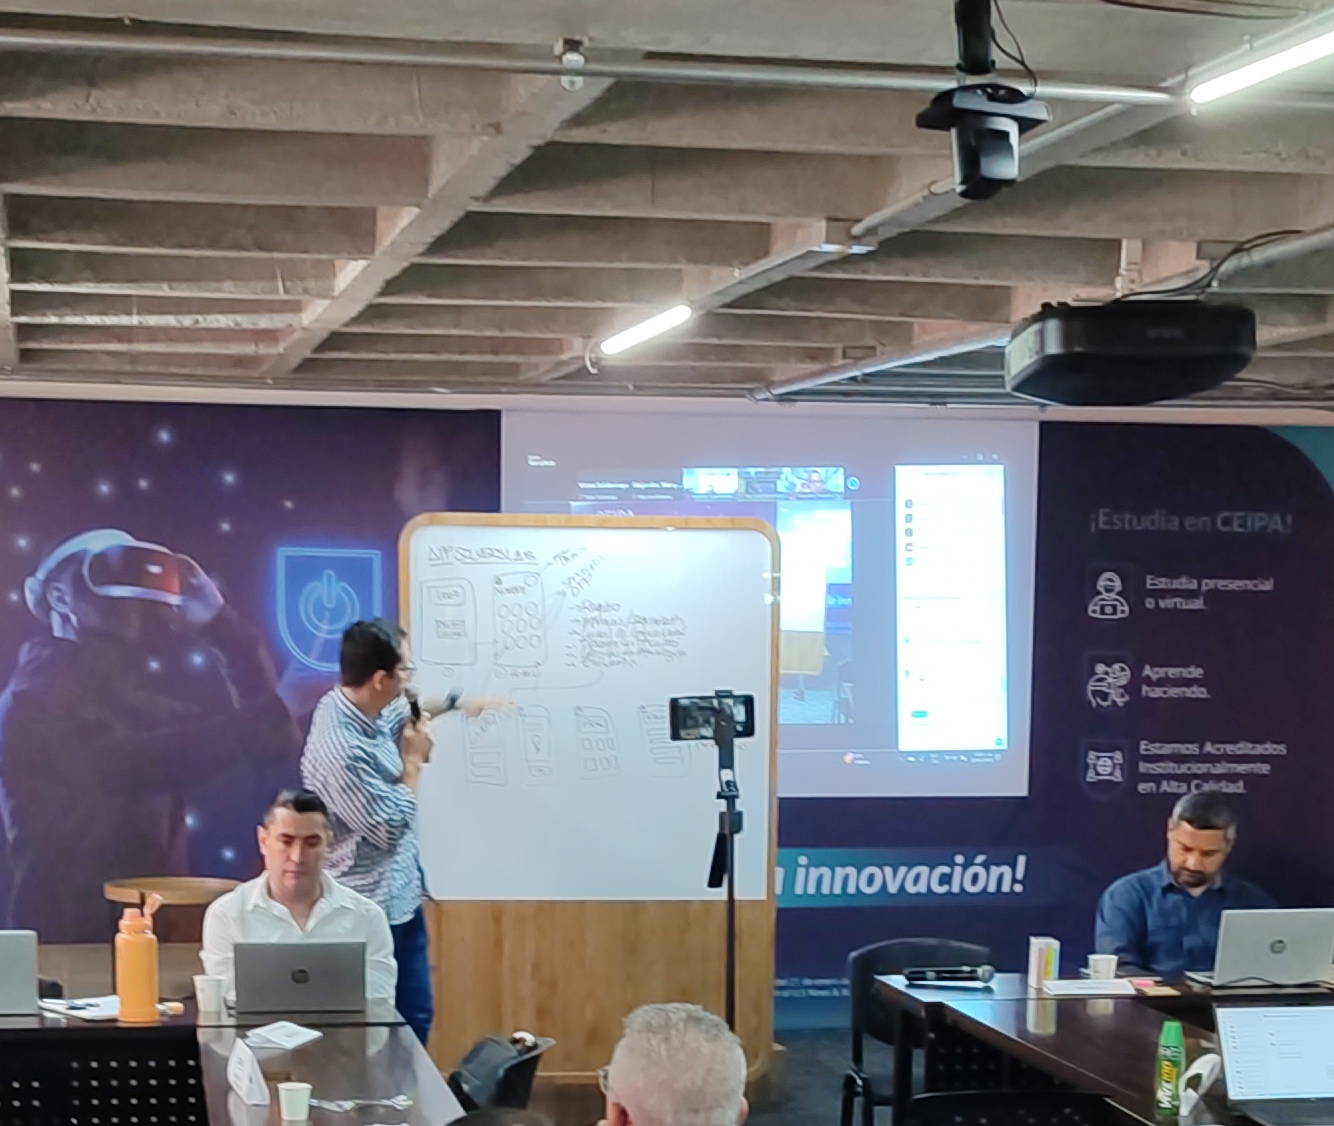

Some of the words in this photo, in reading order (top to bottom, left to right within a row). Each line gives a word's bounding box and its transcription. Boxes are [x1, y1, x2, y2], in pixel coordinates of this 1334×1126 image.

[1090, 508, 1179, 532] ¡Estudia
[1184, 515, 1211, 531] en
[1217, 511, 1293, 533] CEIPA!
[1145, 575, 1198, 590] Estudia
[1201, 577, 1274, 592] presencial
[1145, 598, 1155, 609] o
[1158, 596, 1207, 610] virtual.
[1142, 664, 1204, 681] Aprende
[1141, 684, 1211, 698] haciendo.
[1139, 740, 1200, 755] Estamos
[1202, 741, 1287, 755] Acreditados
[1138, 760, 1271, 775] Institucionalmente
[1137, 782, 1157, 793] en
[1159, 779, 1188, 793] Alta
[794, 853, 1027, 895] innovación!
